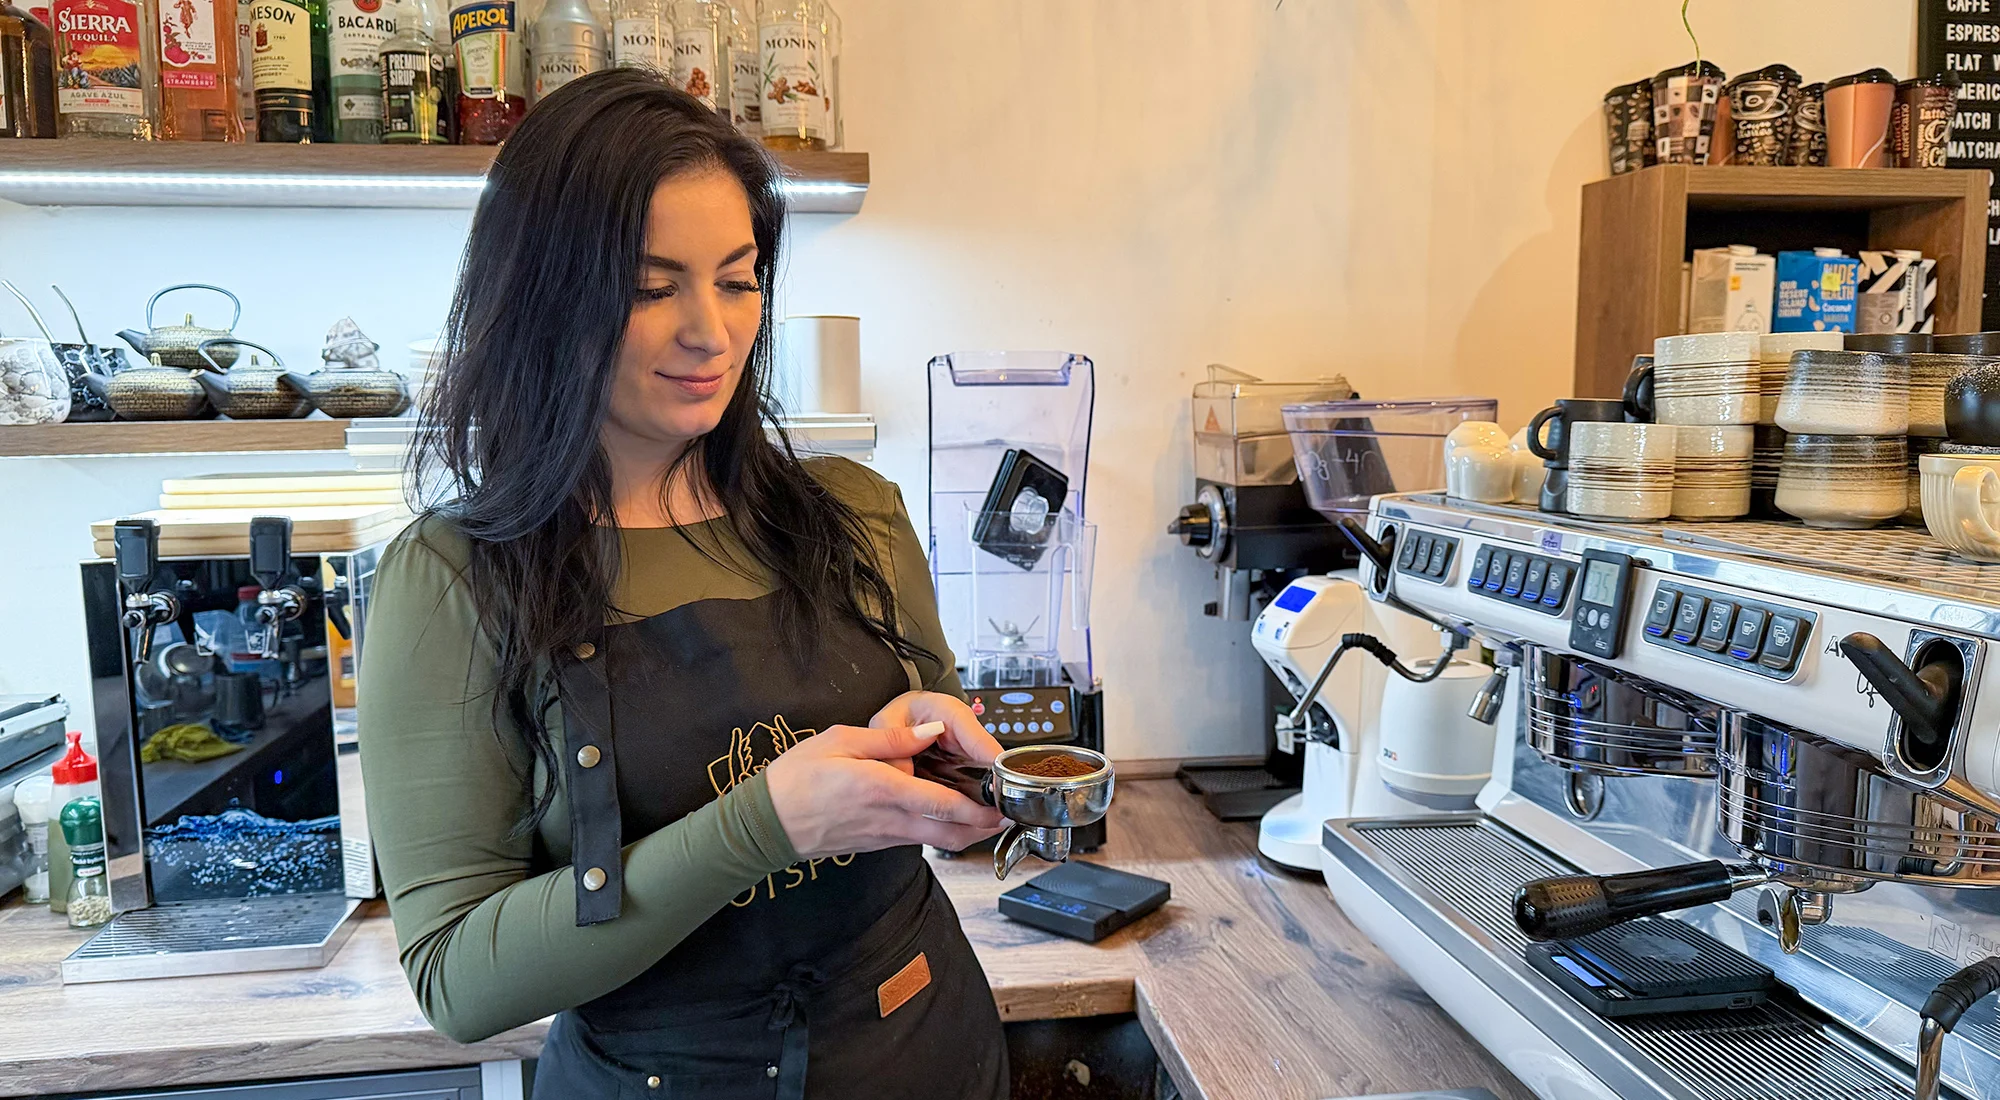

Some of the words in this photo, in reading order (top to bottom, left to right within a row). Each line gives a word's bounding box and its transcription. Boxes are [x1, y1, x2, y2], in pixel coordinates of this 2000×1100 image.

[1947, 0, 1990, 12] CAFFE
[58, 7, 132, 34] SIERRA
[453, 8, 509, 38] APEROL
[71, 33, 118, 42] TEQUILA
[1946, 23, 2000, 43] ESPRES
[765, 37, 817, 50] MONIN
[539, 63, 589, 74] MONIN
[1946, 53, 1982, 71] FLAT
[166, 78, 214, 86] STRAWBERRY
[389, 70, 416, 86] SIRUP
[70, 91, 98, 99] AGAVE
[100, 91, 126, 100] AZUL
[1957, 83, 2000, 101] MERIC
[1952, 112, 1992, 130] ATCH
[1712, 606, 1727, 615] STOP
